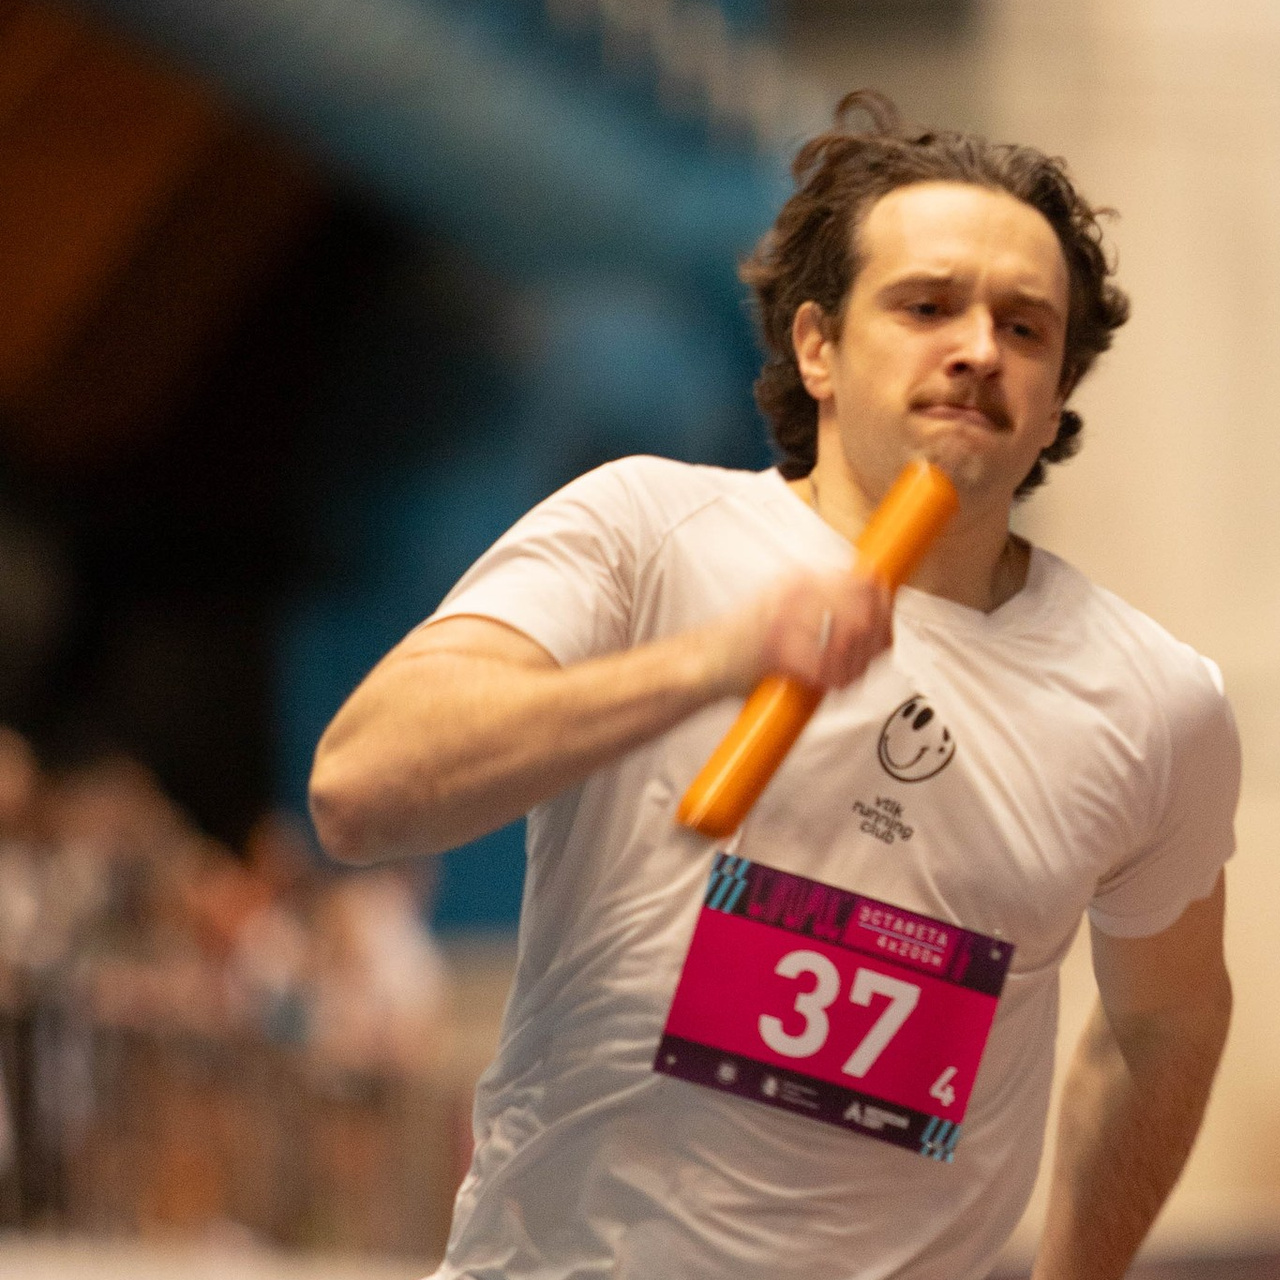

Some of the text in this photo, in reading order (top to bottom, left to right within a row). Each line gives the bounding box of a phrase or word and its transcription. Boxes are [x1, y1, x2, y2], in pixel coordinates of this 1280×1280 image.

[852, 800, 914, 841] running
[860, 820, 895, 844] club
[757, 949, 922, 1078] 37
[928, 1066, 958, 1107] 4
